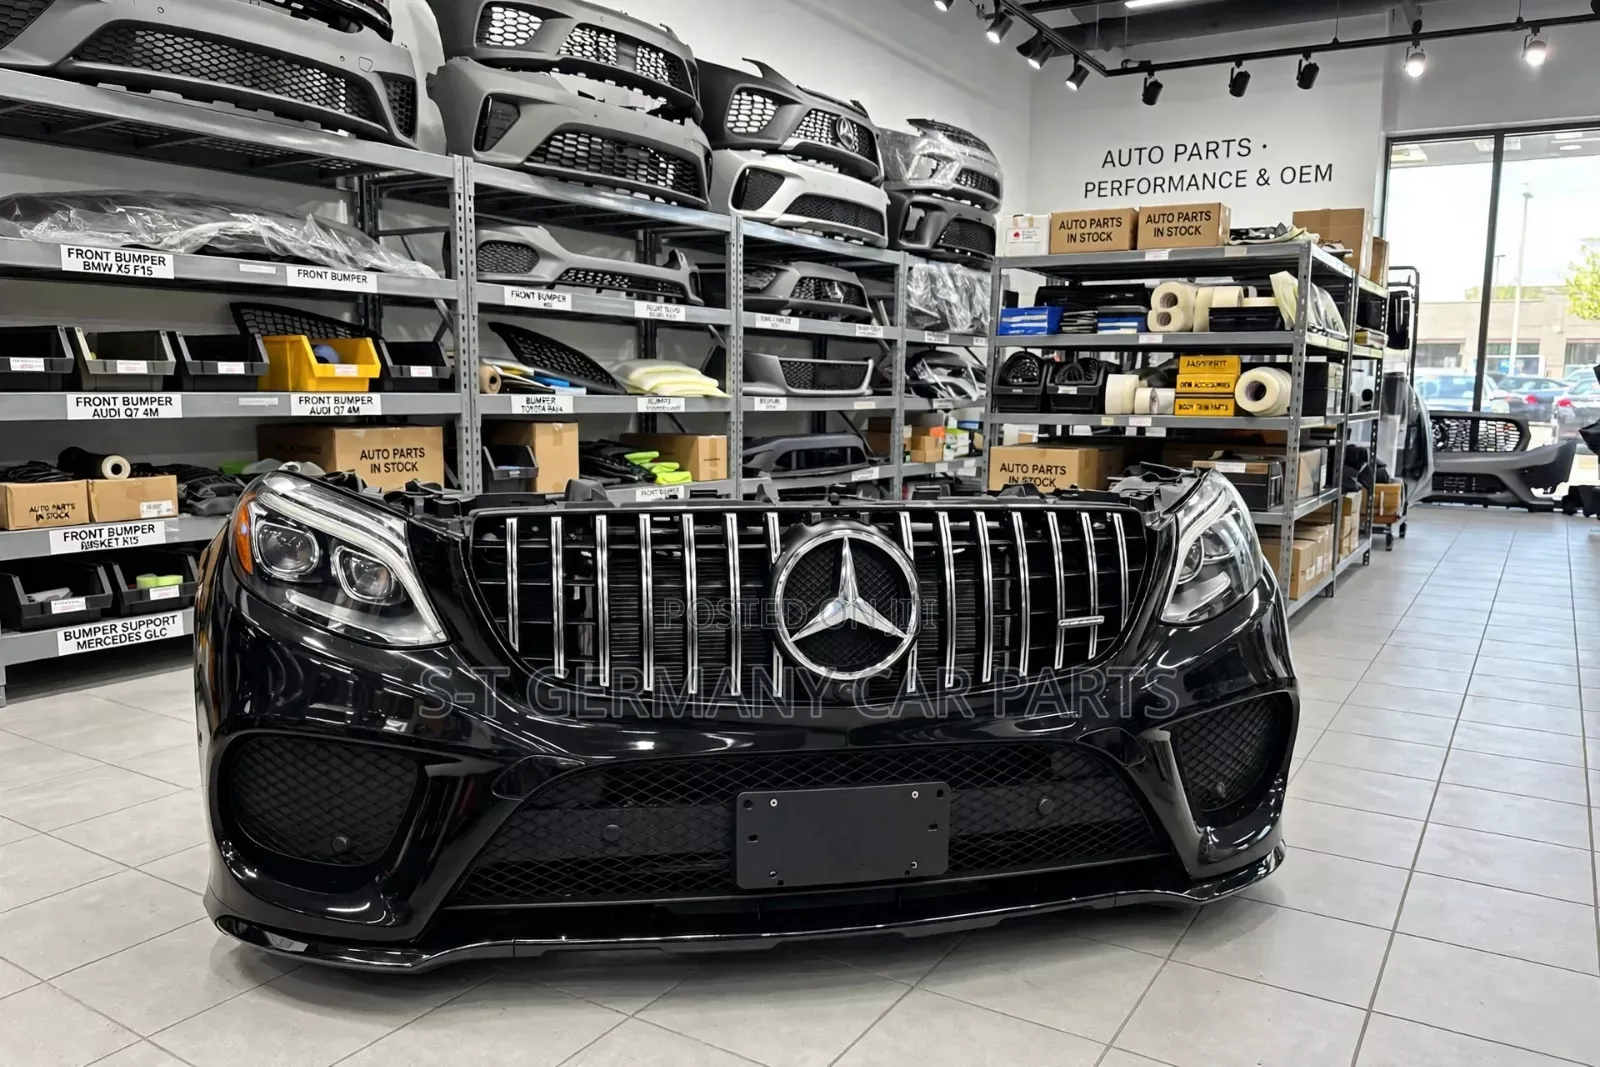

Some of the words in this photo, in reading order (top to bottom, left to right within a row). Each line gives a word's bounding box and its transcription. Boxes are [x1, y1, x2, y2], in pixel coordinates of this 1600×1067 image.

[1101, 146, 1164, 169] AUTO
[1173, 138, 1252, 163] PARTS
[1084, 170, 1248, 199] PERFORMANCE
[1256, 168, 1271, 187] &
[1280, 163, 1333, 185] OEM
[1058, 218, 1087, 230] AUTO
[1089, 216, 1122, 228] PARTS
[1145, 212, 1174, 225] AUTO
[1177, 210, 1212, 222] PARTS
[1066, 233, 1077, 243] IN
[1080, 231, 1113, 242] STOCK
[1153, 227, 1164, 238] IN
[1166, 225, 1201, 237] STOCK
[67, 247, 111, 262] FRONT
[114, 252, 166, 267] BUMPER
[82, 260, 113, 273] BMW
[116, 263, 131, 274] X5
[133, 265, 153, 276] F15
[297, 268, 329, 280] FRONT
[331, 272, 368, 283] BUMPER
[76, 397, 118, 407] FRONT
[122, 396, 173, 407] BUMPER
[299, 396, 331, 405] FRONT
[334, 396, 373, 405] BUMPER
[92, 408, 120, 418] AUDI
[124, 407, 139, 418] Q7
[142, 407, 159, 417] 4M
[347, 405, 360, 414] 4M
[360, 449, 390, 461] AUTO
[392, 447, 425, 459] PARTS
[370, 463, 381, 474] IN
[384, 461, 418, 473] STOCK
[1000, 463, 1029, 474] AUTO
[1032, 464, 1066, 476] PARTS
[1008, 475, 1019, 484] IN
[29, 505, 49, 513] AUTO
[63, 528, 105, 542] FRONT
[108, 524, 156, 538] BUMPER
[64, 624, 118, 641] BUMPER
[121, 615, 178, 632] SUPPORT
[76, 632, 141, 650] MERCEDES
[144, 628, 168, 640] GLC
